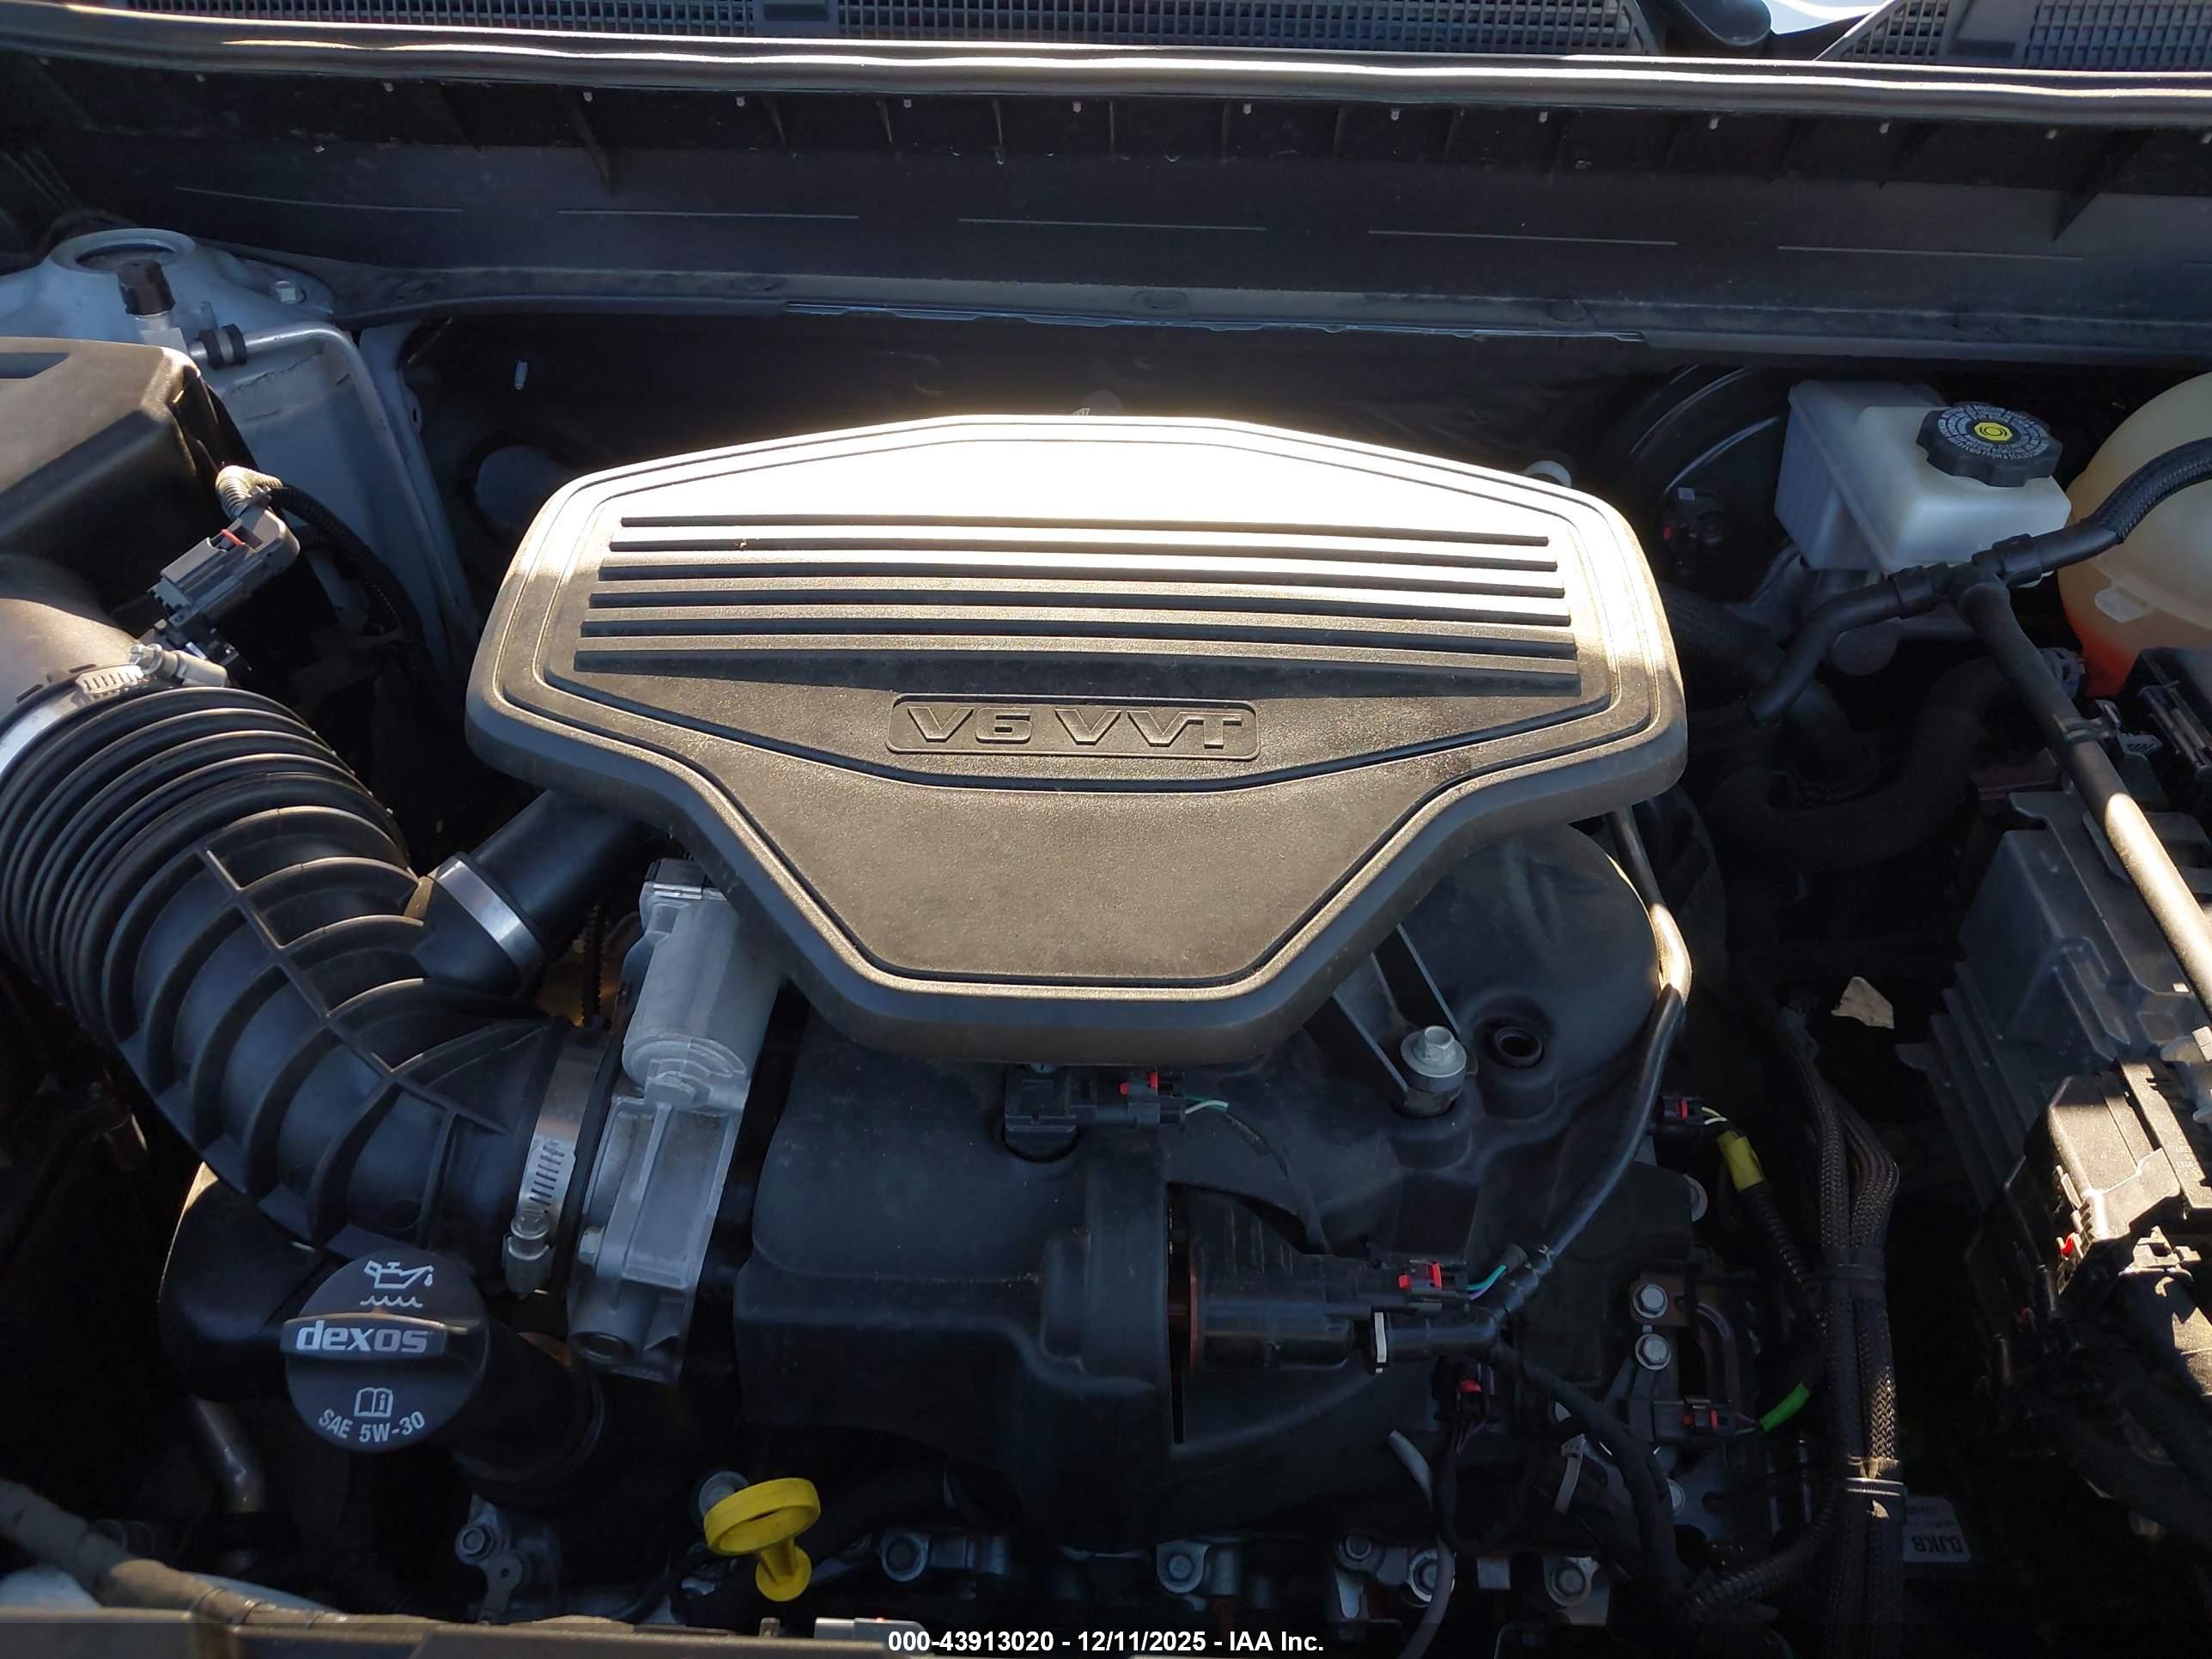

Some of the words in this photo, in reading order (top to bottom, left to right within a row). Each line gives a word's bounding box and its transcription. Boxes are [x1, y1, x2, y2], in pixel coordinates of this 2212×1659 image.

[907, 706, 1033, 744] V6
[1054, 708, 1244, 750] VVT
[295, 1319, 429, 1353] dexos
[318, 1408, 354, 1439] SAE
[358, 1410, 426, 1443] 5W-30
